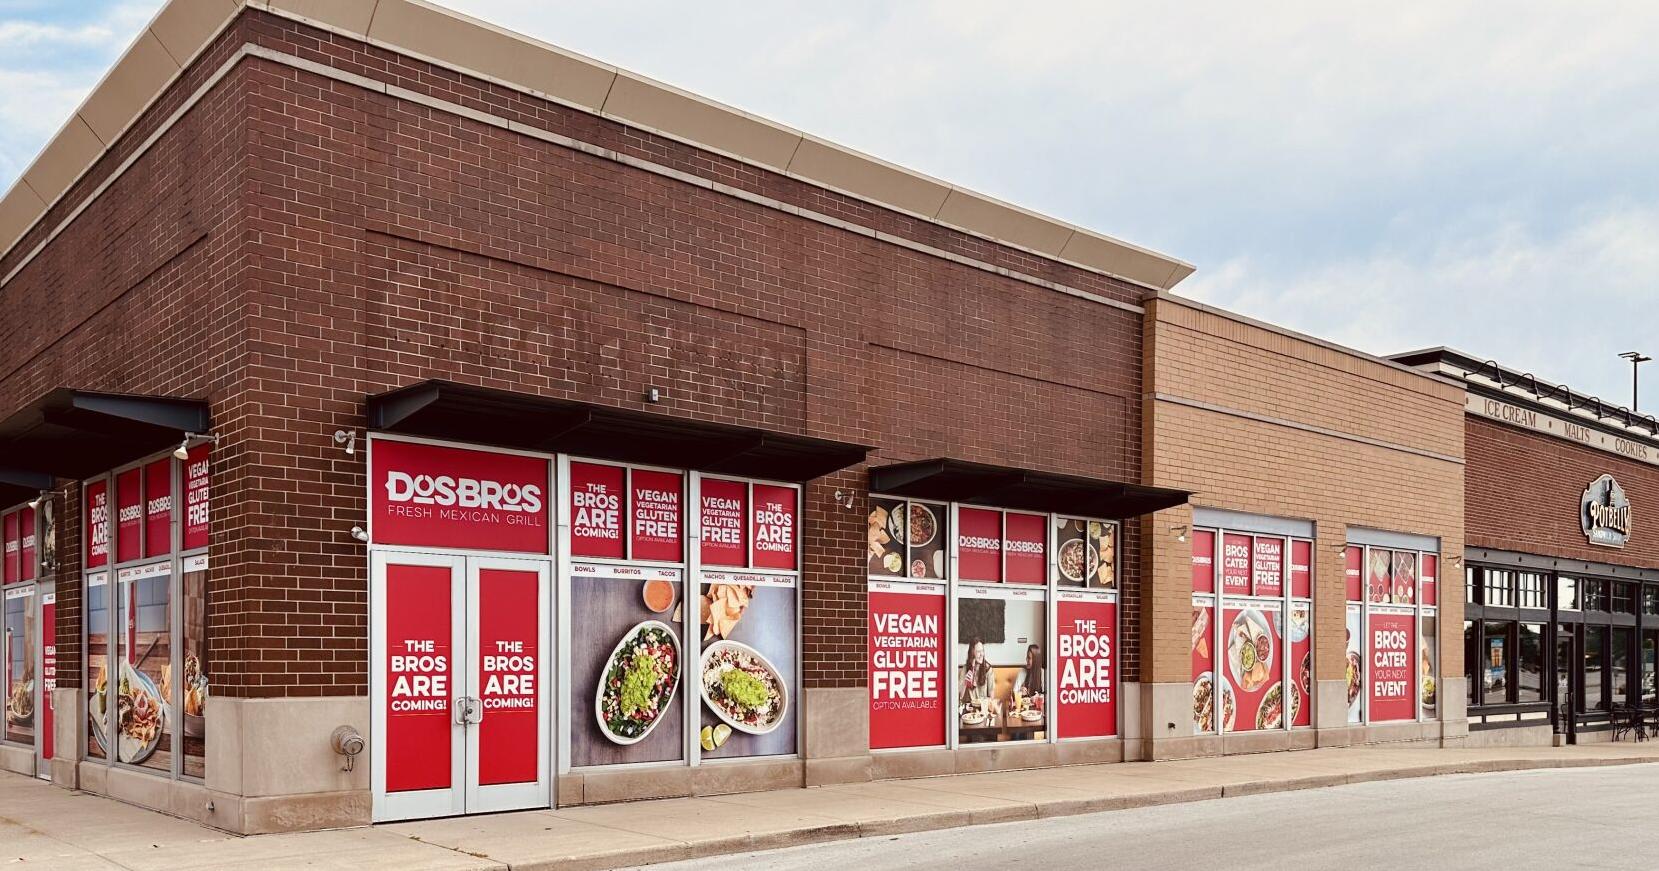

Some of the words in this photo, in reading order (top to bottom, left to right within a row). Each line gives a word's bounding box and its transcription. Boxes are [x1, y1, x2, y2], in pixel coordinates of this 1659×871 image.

[1484, 399, 1500, 417] ICE
[1502, 404, 1536, 428] CREAM
[1564, 422, 1590, 442] MALTS
[1615, 438, 1648, 460] COOKIES
[587, 483, 606, 494] THE
[574, 492, 618, 509] BROS
[636, 489, 677, 503] VEGAN
[636, 501, 677, 511] VEGETARIAN
[702, 497, 740, 510] VEGAN
[766, 503, 782, 512] THE
[388, 505, 432, 518] FRESH
[440, 509, 499, 523] MEXICAN
[507, 515, 541, 526] GRILL
[574, 508, 618, 529] ARE
[636, 509, 677, 522] GLUTEN
[702, 509, 740, 517] VEGETARIAN
[756, 510, 792, 526] BROS
[1590, 500, 1631, 534] POTBELLY
[636, 520, 677, 538] FREE
[702, 516, 740, 528] GLUTEN
[574, 527, 618, 539] COMING!
[702, 526, 740, 543] FREE
[756, 525, 792, 543] ARE
[756, 542, 792, 552] COMING!
[1225, 545, 1248, 558] BROS
[1255, 543, 1280, 554] VEGAN
[1225, 558, 1248, 568] CATER
[1256, 560, 1280, 570] GLUTEN
[1225, 576, 1248, 586] EVENT
[1255, 570, 1280, 585] FREE
[874, 613, 937, 634] VEGAN
[1075, 620, 1096, 633] THE
[405, 640, 434, 652] THE
[496, 641, 523, 652] THE
[874, 636, 937, 648] VEGETARIAN
[1060, 635, 1110, 657] BROS
[1375, 630, 1407, 649] BROS
[391, 656, 447, 672] BROS
[484, 656, 534, 671] BROS
[873, 651, 937, 668] GLUTEN
[1375, 652, 1406, 667] CATER
[1060, 659, 1110, 688] ARE
[1375, 669, 1390, 678] YOUR
[1392, 669, 1406, 678] NEXT
[392, 675, 446, 697] ARE
[484, 675, 534, 695] ARE
[873, 671, 937, 699] FREE
[1375, 681, 1407, 697] EVENT
[484, 698, 533, 708] COMING!
[1060, 689, 1110, 704] COMING!
[391, 700, 446, 711] COMING!
[873, 701, 900, 710] OPTION
[902, 700, 936, 709] AVAILABLE
